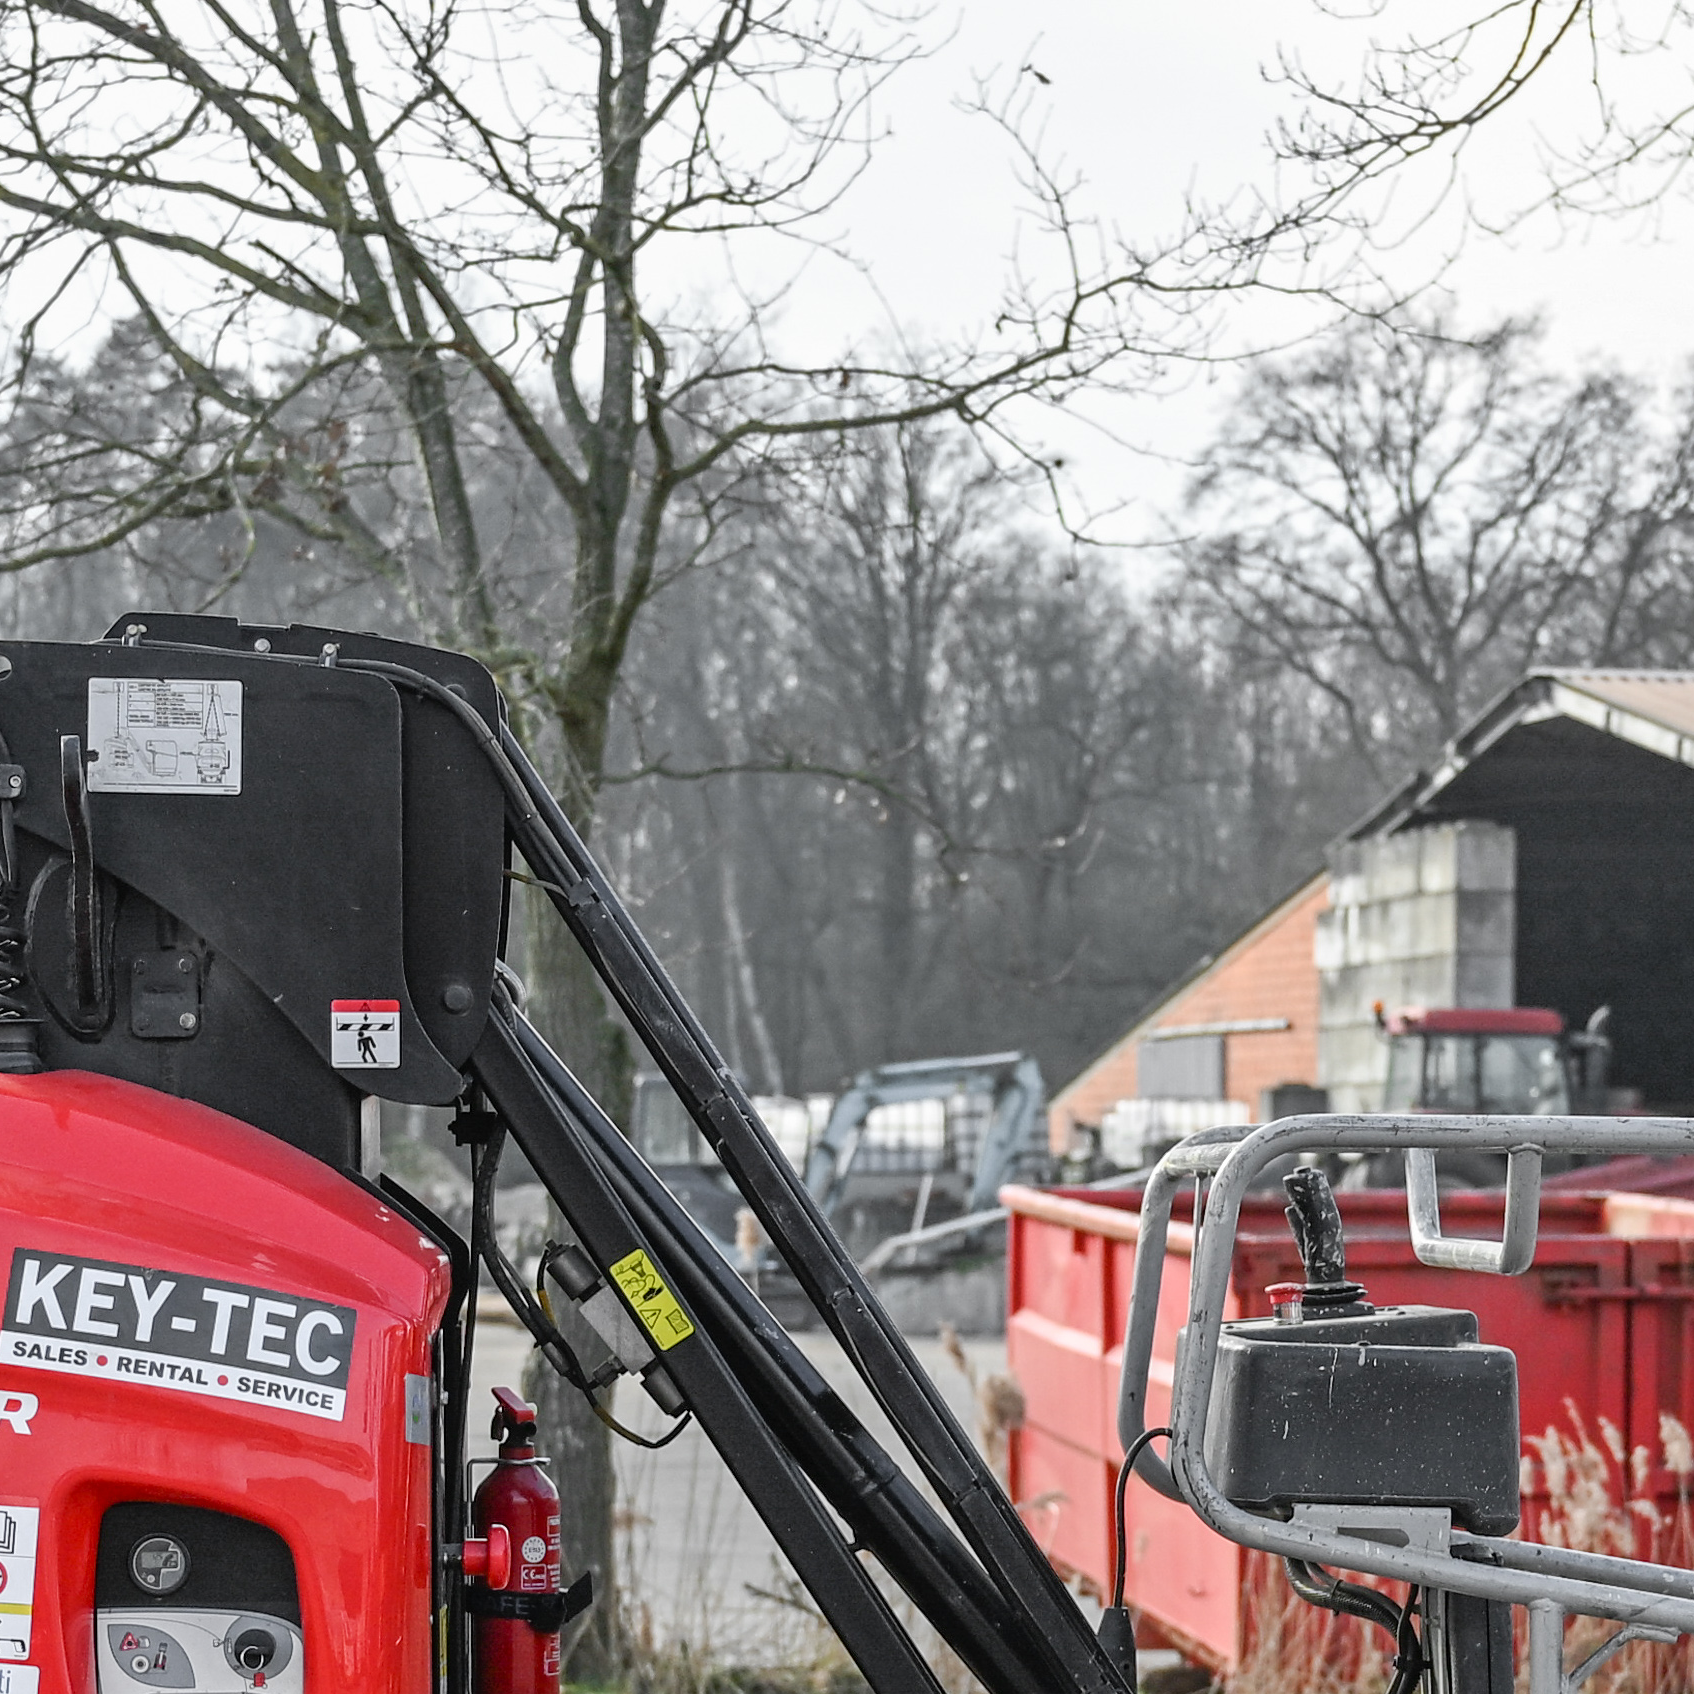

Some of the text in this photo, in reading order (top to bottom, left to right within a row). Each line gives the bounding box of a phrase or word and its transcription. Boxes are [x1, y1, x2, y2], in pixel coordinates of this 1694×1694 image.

[15, 1259, 344, 1377] KEY-TEC
[12, 1341, 335, 1410] SALES RENTAL SERVICE
